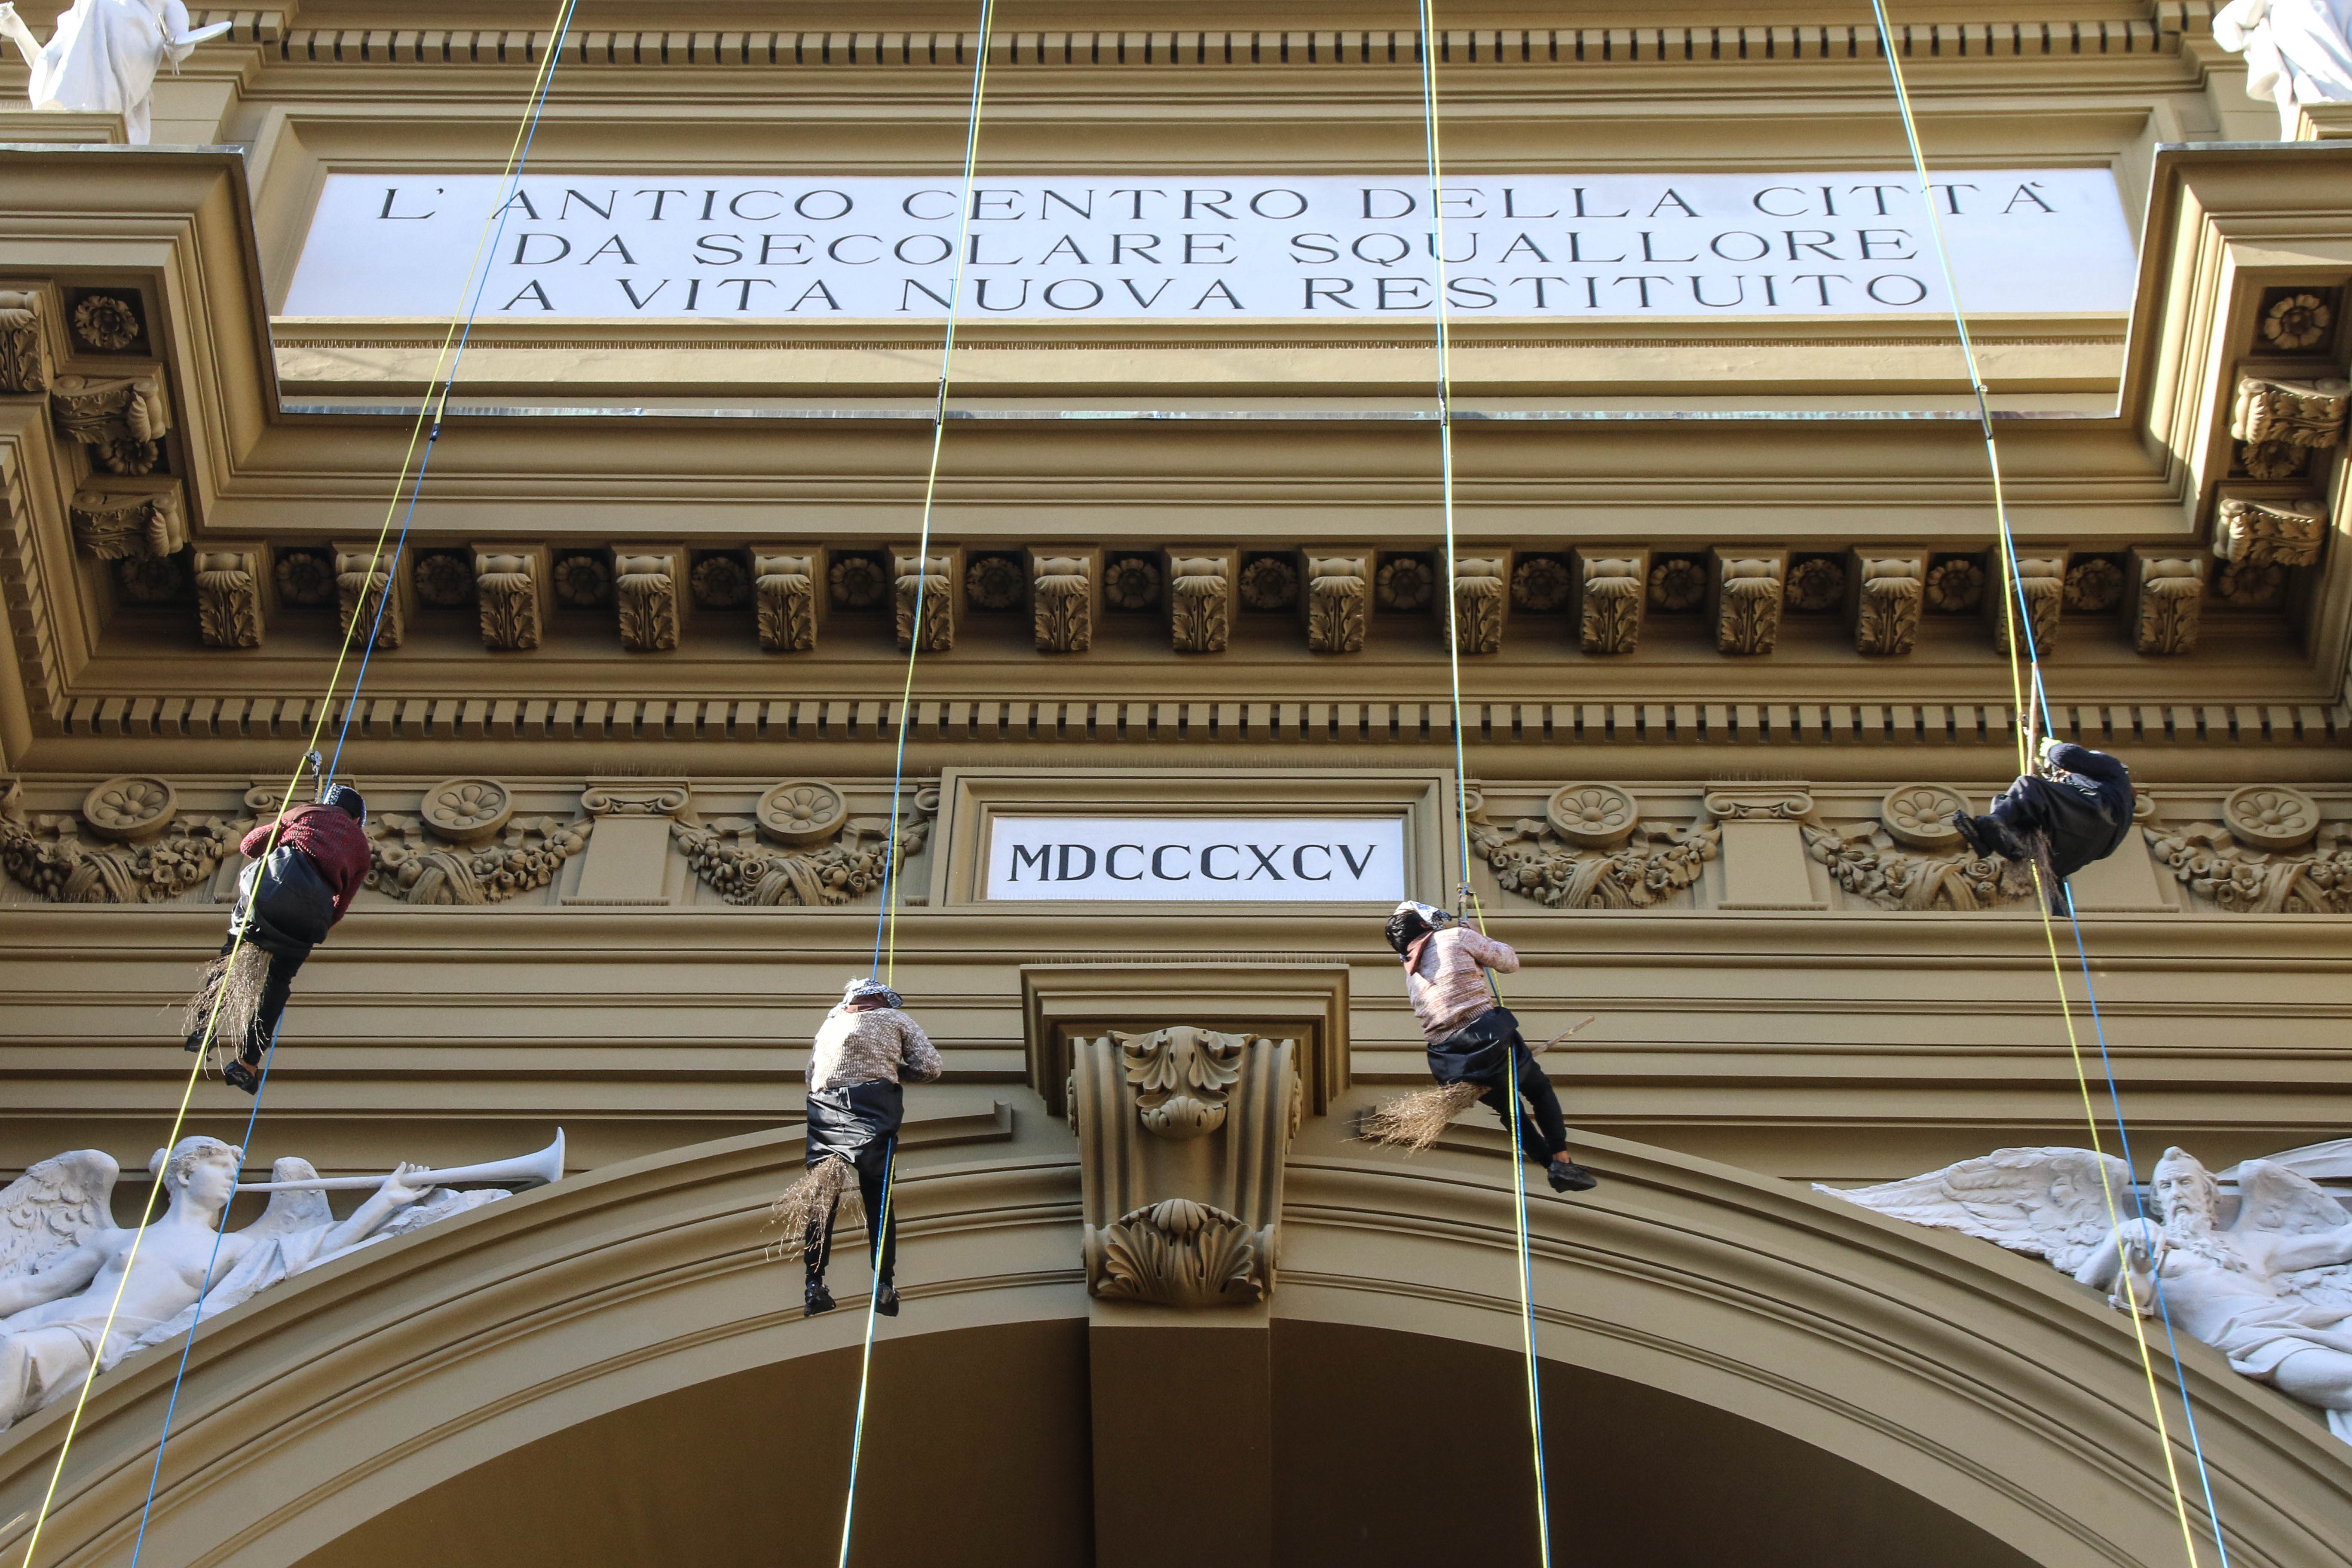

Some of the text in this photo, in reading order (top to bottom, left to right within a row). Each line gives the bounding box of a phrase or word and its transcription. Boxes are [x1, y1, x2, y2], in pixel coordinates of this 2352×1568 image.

[901, 190, 1308, 220] CENTRO
[1359, 188, 1701, 218] DELLA
[1752, 181, 2059, 217] CITTÀ
[508, 230, 1917, 267] DA SECOLARE SQUALLORE
[498, 275, 1928, 312] A VITA NUOVA RESTITUITO
[1007, 844, 1378, 882] MDCCCXCV
